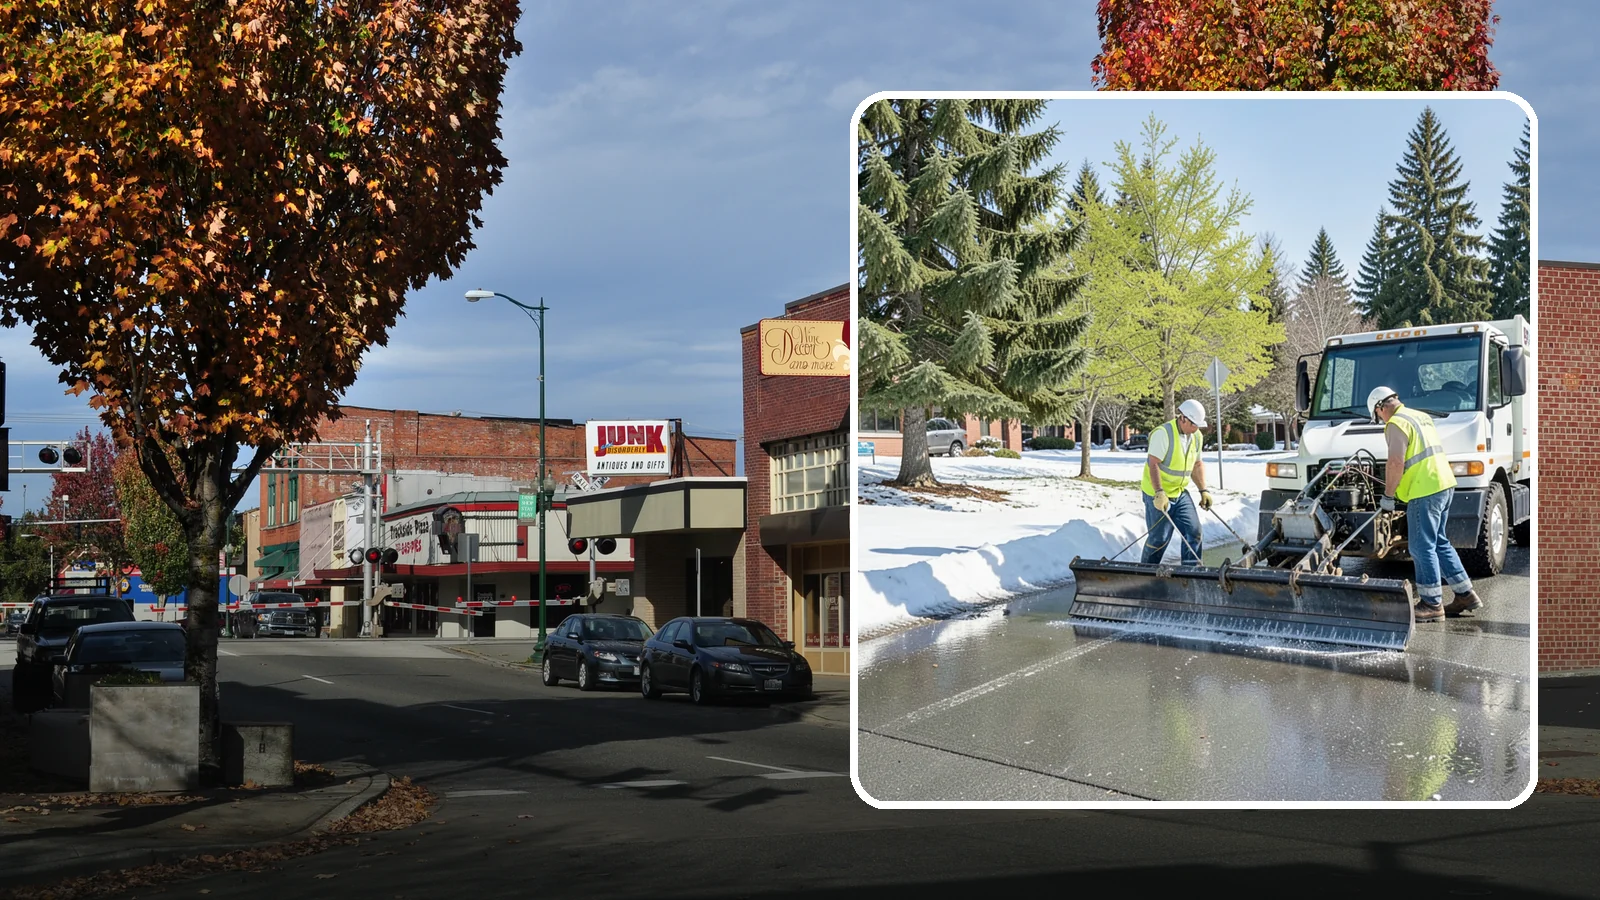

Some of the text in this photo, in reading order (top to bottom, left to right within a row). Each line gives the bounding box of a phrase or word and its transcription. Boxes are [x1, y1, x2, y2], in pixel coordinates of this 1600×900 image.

[595, 425, 665, 457] JUNK
[607, 446, 646, 454] DISORDERLY
[597, 460, 665, 470] ANTIQUES AND GIFTS
[414, 519, 429, 535] Pizza
